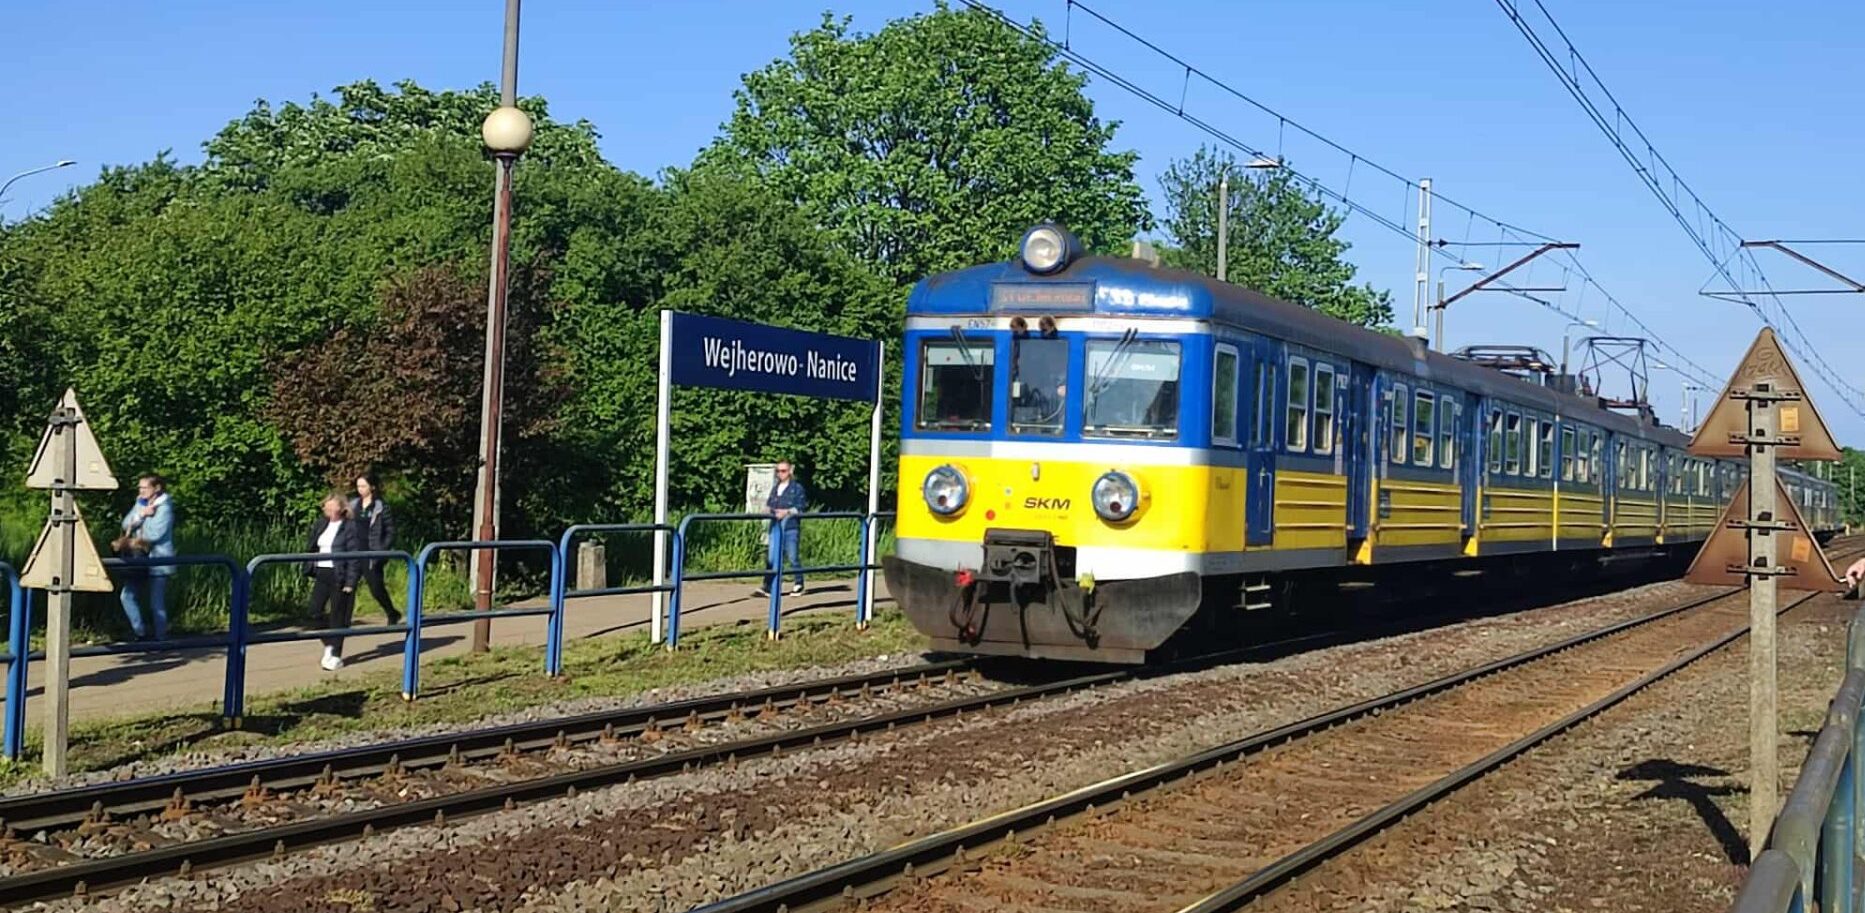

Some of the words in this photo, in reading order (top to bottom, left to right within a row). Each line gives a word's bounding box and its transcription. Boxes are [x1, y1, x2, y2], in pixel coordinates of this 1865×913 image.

[703, 336, 798, 377] Wejherowo
[806, 350, 857, 382] Nanice
[1024, 496, 1071, 511] SKM
